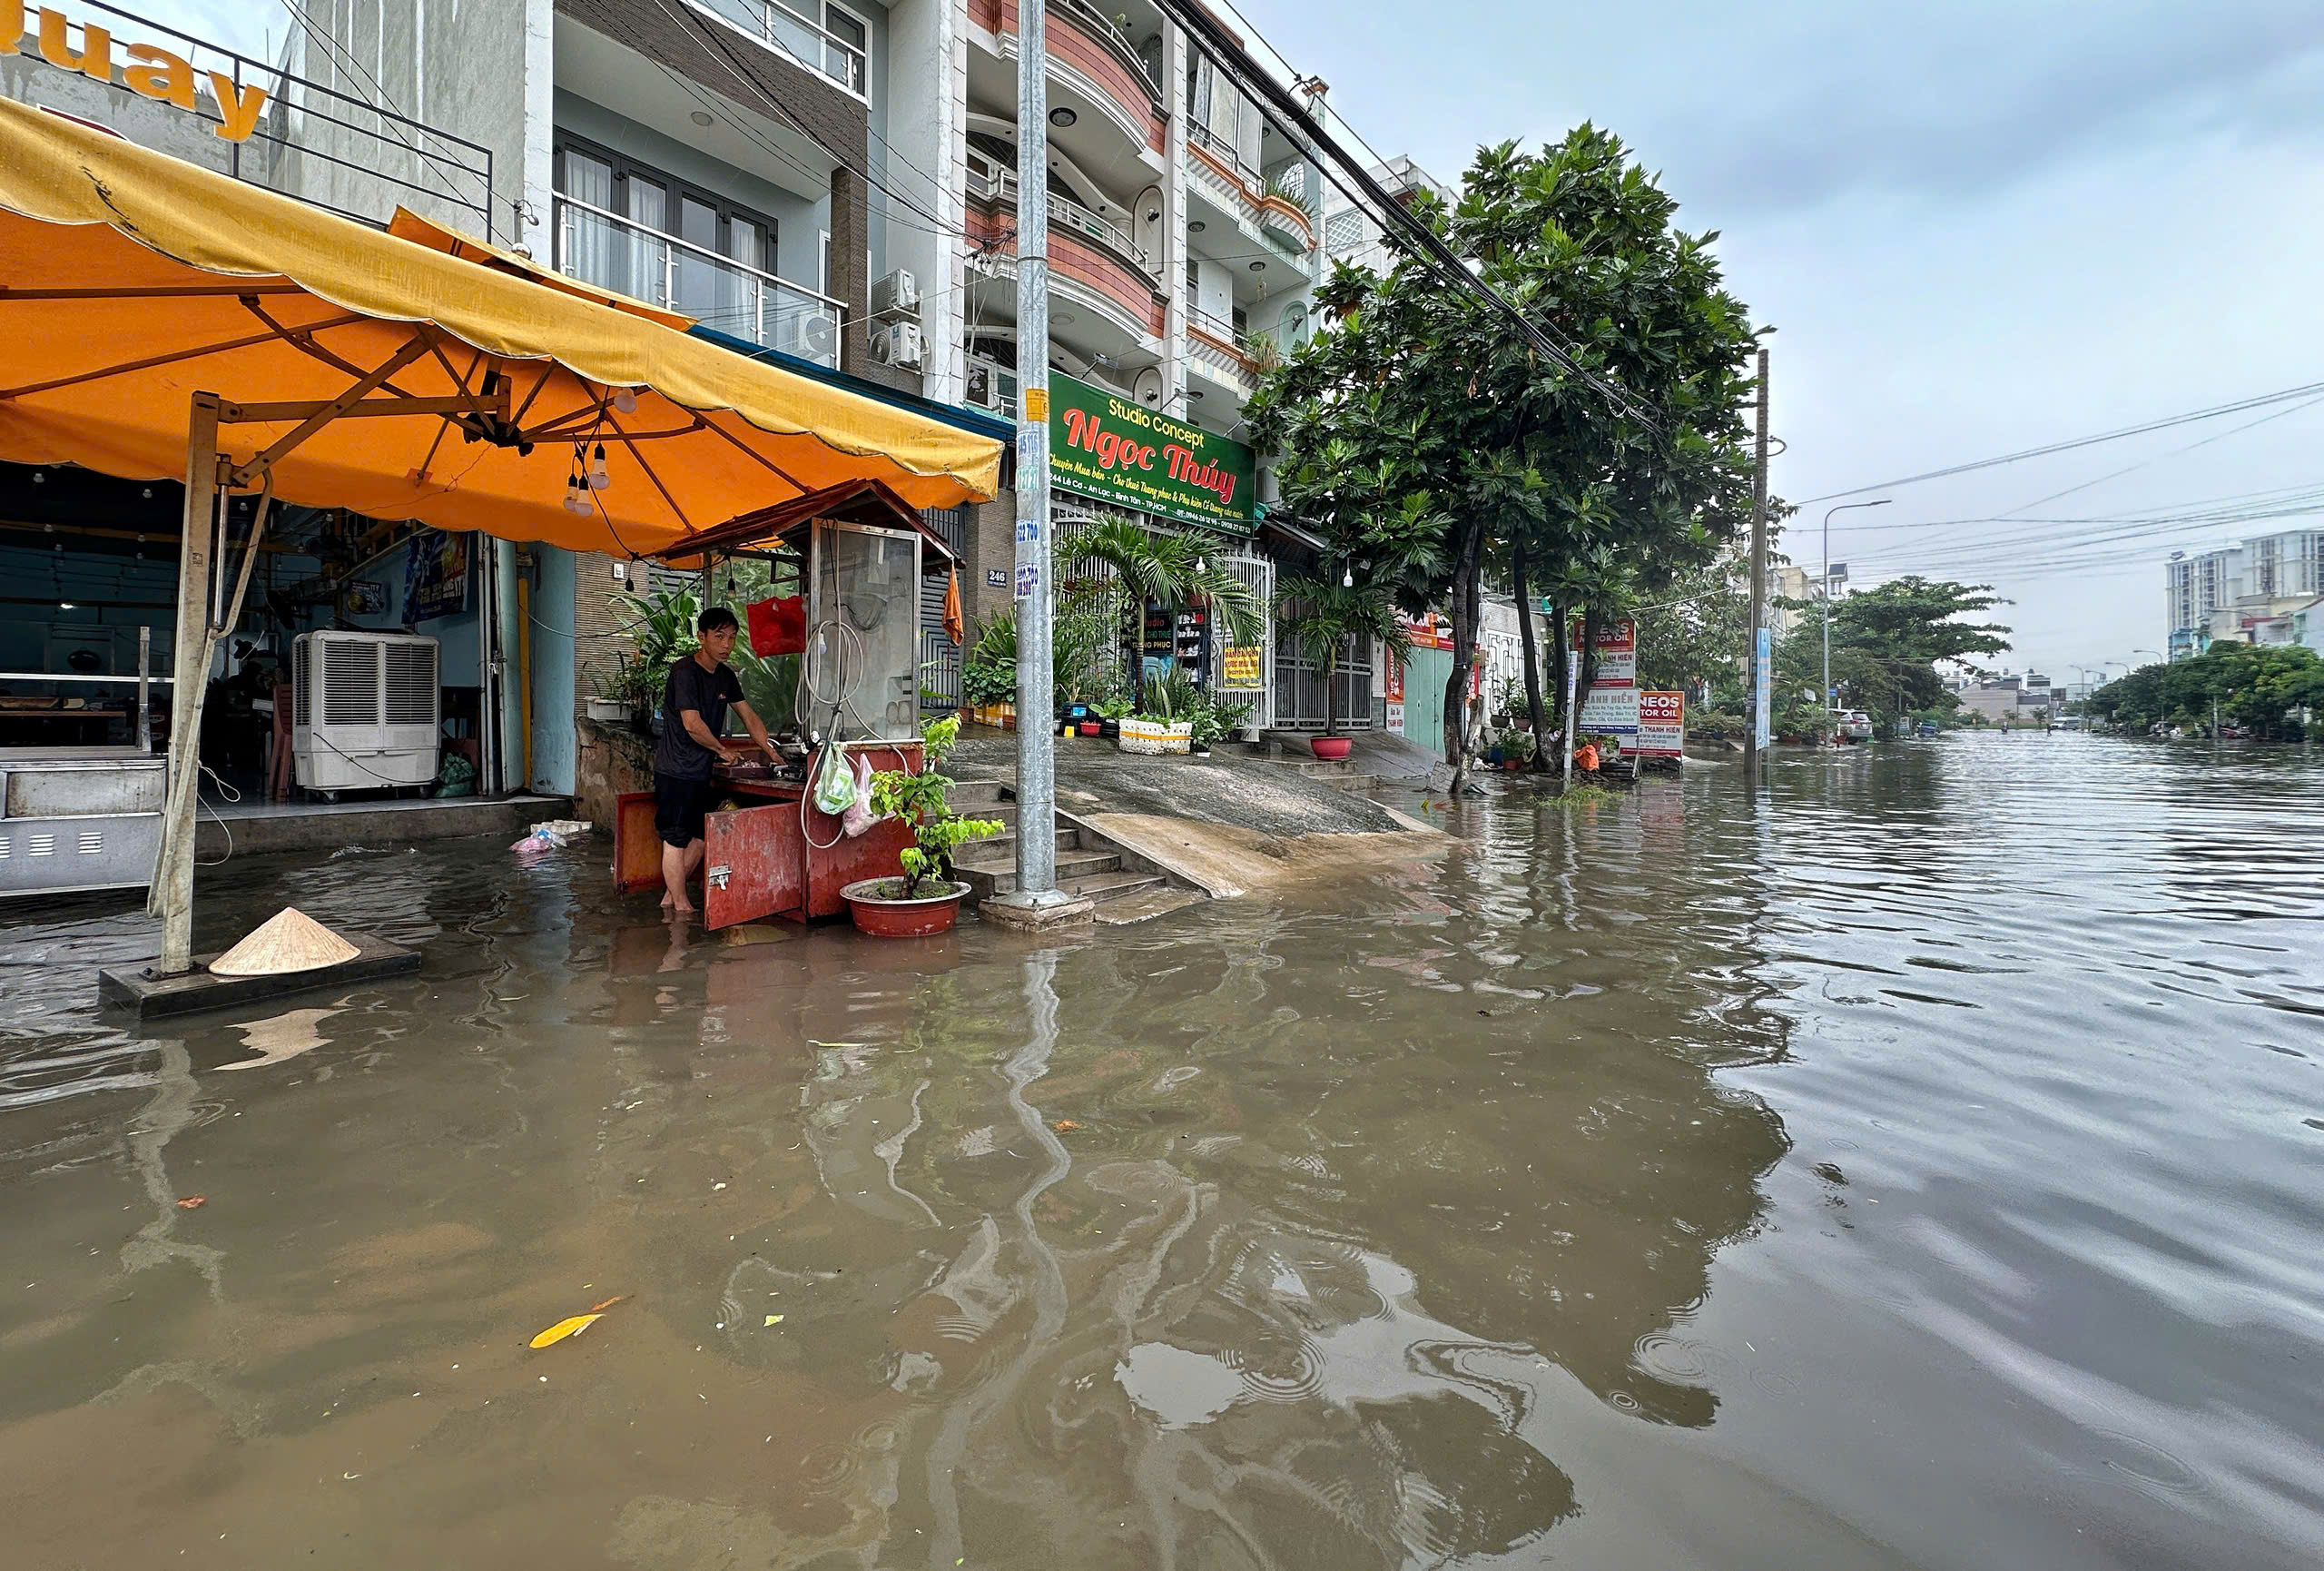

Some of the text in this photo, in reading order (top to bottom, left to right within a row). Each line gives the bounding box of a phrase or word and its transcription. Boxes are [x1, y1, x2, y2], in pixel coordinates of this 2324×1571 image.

[1108, 399, 1205, 450] Studio Concept
[1063, 409, 1236, 504] Ngọc Thúy
[1074, 461, 1090, 476] Mua
[1091, 466, 1105, 480] bán
[1113, 473, 1125, 487] Cho
[1126, 477, 1139, 490] thuê
[1063, 477, 1071, 486] Lê
[1072, 479, 1082, 489] Cơ
[1088, 485, 1098, 494] An
[1098, 488, 1110, 498] Lạc
[1116, 491, 1128, 502] Bình
[1129, 495, 1140, 505] Tân
[990, 570, 1005, 582] 246
[1153, 641, 1171, 650] PHỤC
[1614, 634, 1630, 642] OIL
[1640, 697, 1679, 708] NEOS
